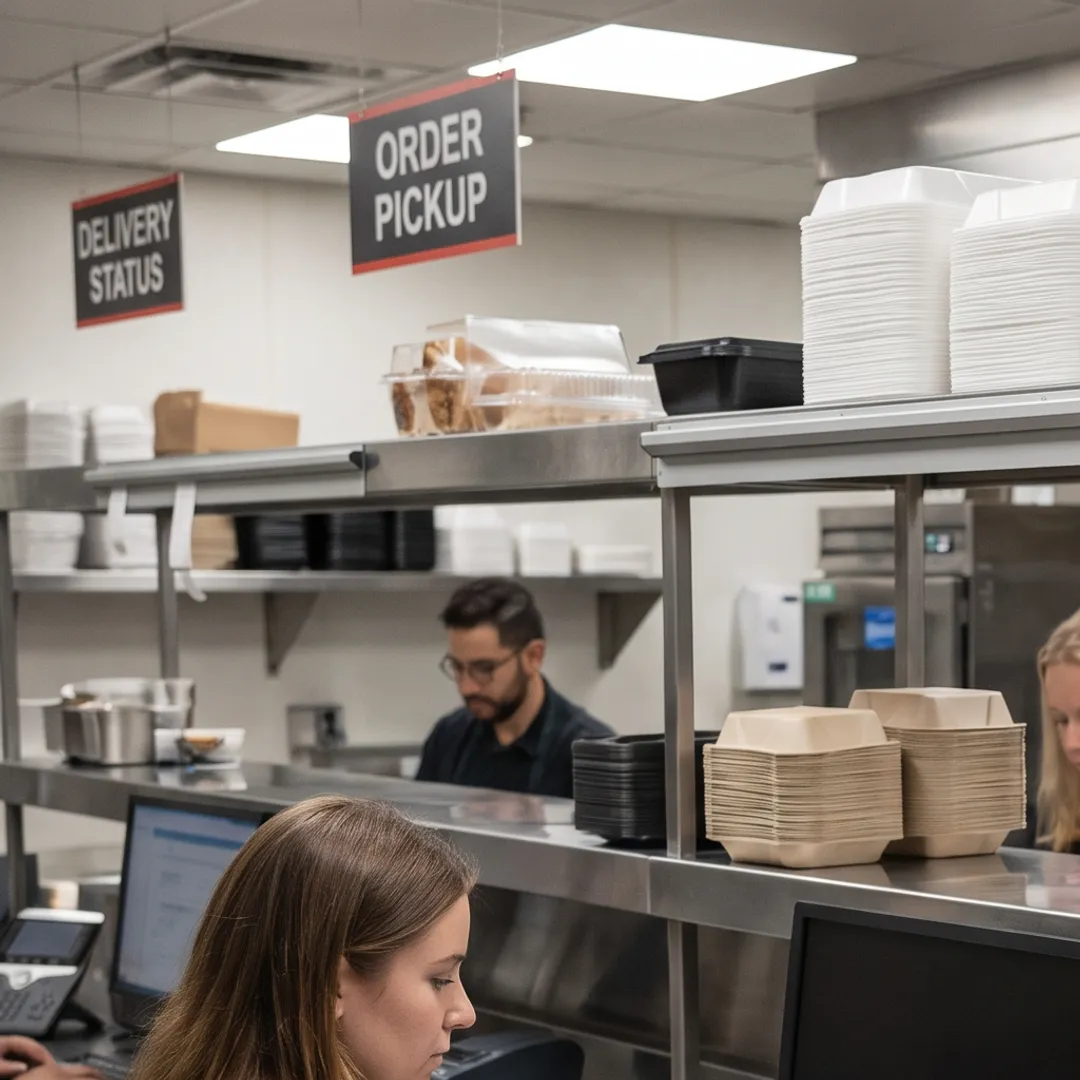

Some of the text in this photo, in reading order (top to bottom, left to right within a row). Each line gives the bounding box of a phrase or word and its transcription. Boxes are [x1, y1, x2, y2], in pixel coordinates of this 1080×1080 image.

[375, 107, 485, 181] ORDER
[78, 200, 174, 259] DELIVERY
[374, 171, 488, 242] PICKUP
[89, 252, 164, 304] STATUS
